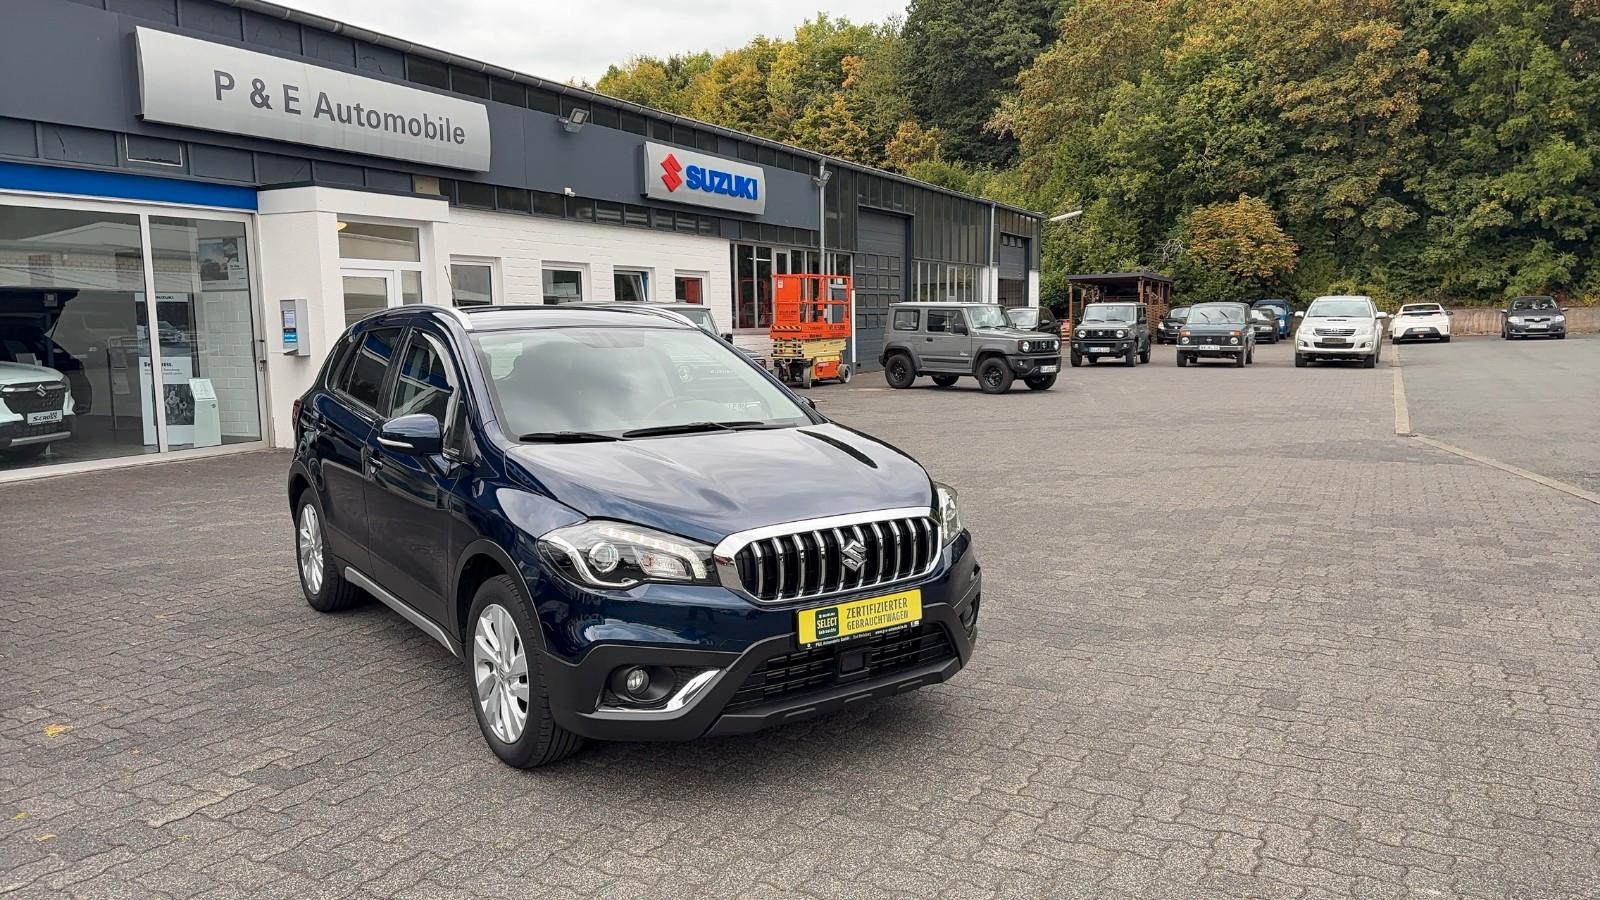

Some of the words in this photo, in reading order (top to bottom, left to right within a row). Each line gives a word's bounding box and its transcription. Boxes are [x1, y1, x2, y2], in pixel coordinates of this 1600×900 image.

[213, 70, 235, 101] P
[249, 78, 273, 110] &
[283, 84, 302, 115] E
[313, 91, 466, 145] Automobile
[686, 165, 758, 200] SUZUKI
[846, 597, 907, 619] ZERTIFIZIERTER
[816, 616, 838, 630] SELECT
[847, 610, 909, 631] GEBRAUCHTWAGEN
